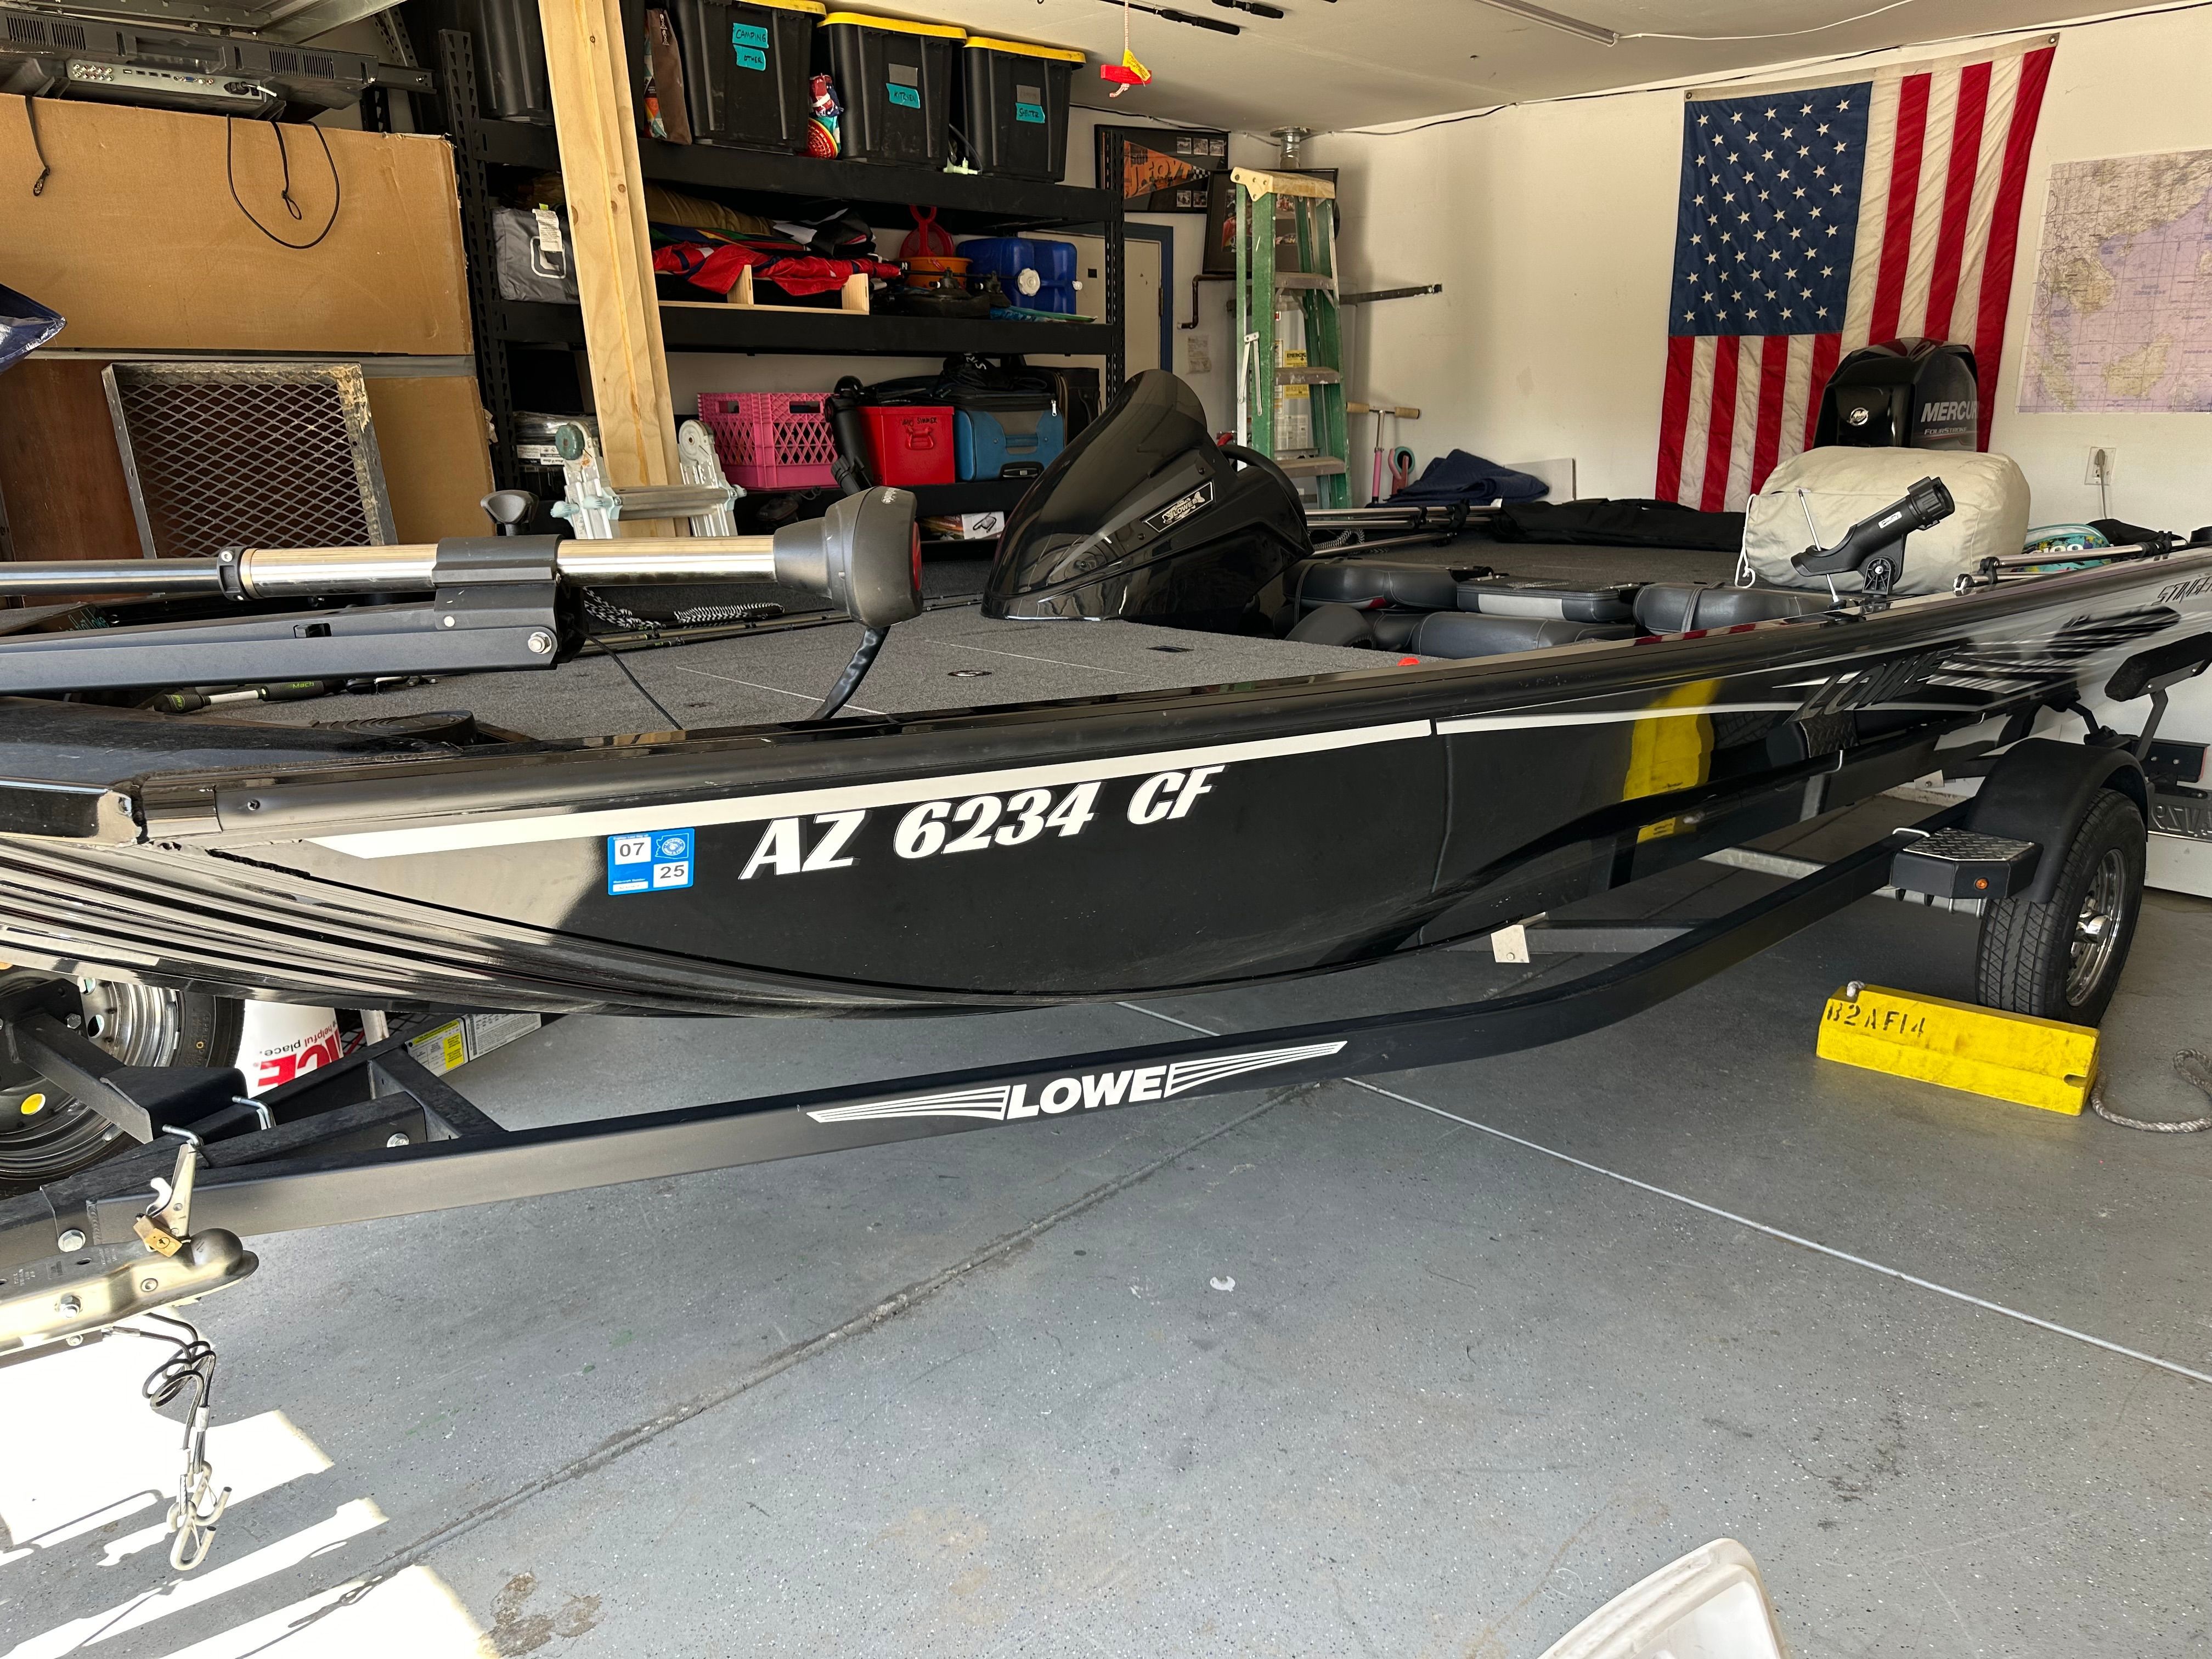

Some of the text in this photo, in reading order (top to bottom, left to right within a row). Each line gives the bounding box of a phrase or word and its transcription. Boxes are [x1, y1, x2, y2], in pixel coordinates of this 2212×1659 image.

[736, 29, 766, 42] CAMPING
[744, 55, 763, 64] OTHER
[1144, 159, 1193, 180] FOYT
[1920, 400, 1979, 423] MERCUR
[1172, 499, 1194, 517] LOWE
[1782, 646, 1961, 725] LOWE
[738, 764, 1227, 880] AZ 6234 CF
[619, 842, 645, 857] 07
[660, 865, 685, 879] 25
[304, 1024, 332, 1047] helpful
[1006, 1065, 1167, 1120] LOWE
